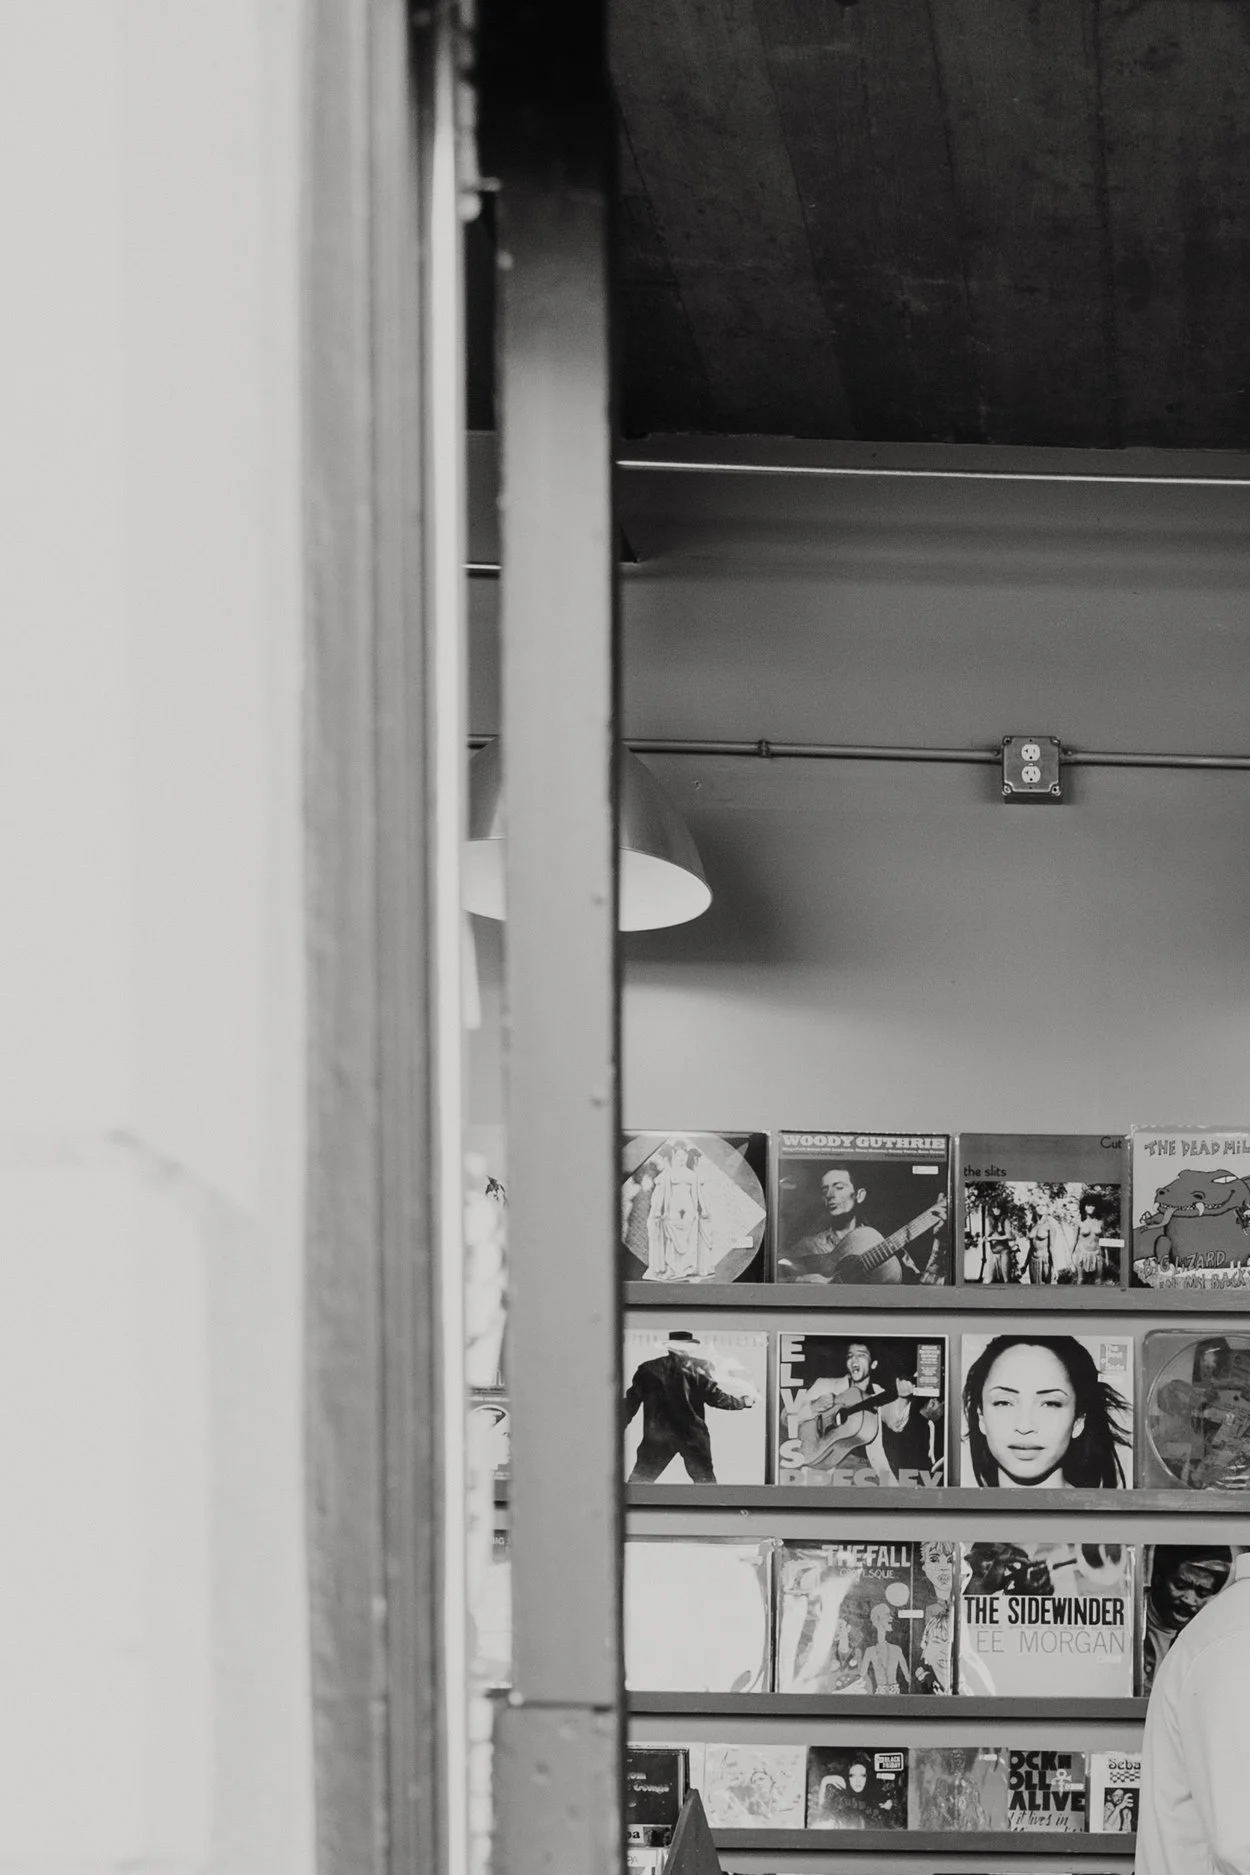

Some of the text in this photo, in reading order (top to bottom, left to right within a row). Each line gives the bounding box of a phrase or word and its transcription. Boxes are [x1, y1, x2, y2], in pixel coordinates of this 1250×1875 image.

[782, 1134, 946, 1149] WOODY GUTHRIE
[1100, 1136, 1122, 1150] Cut
[1144, 1139, 1176, 1156] THE
[1181, 1139, 1221, 1156] DEAD
[963, 1166, 1007, 1177] the slits
[779, 1334, 807, 1469] ELVIS
[821, 1544, 911, 1568] THE FALL
[964, 1597, 1125, 1626] THE SIDEWINDER
[976, 1630, 1126, 1654] EE MORGAN
[1108, 1758, 1141, 1770] Seba
[1009, 1770, 1052, 1790] OLL
[1009, 1790, 1086, 1812] ALIVE
[1027, 1811, 1052, 1827] lives
[1055, 1812, 1069, 1827] in
